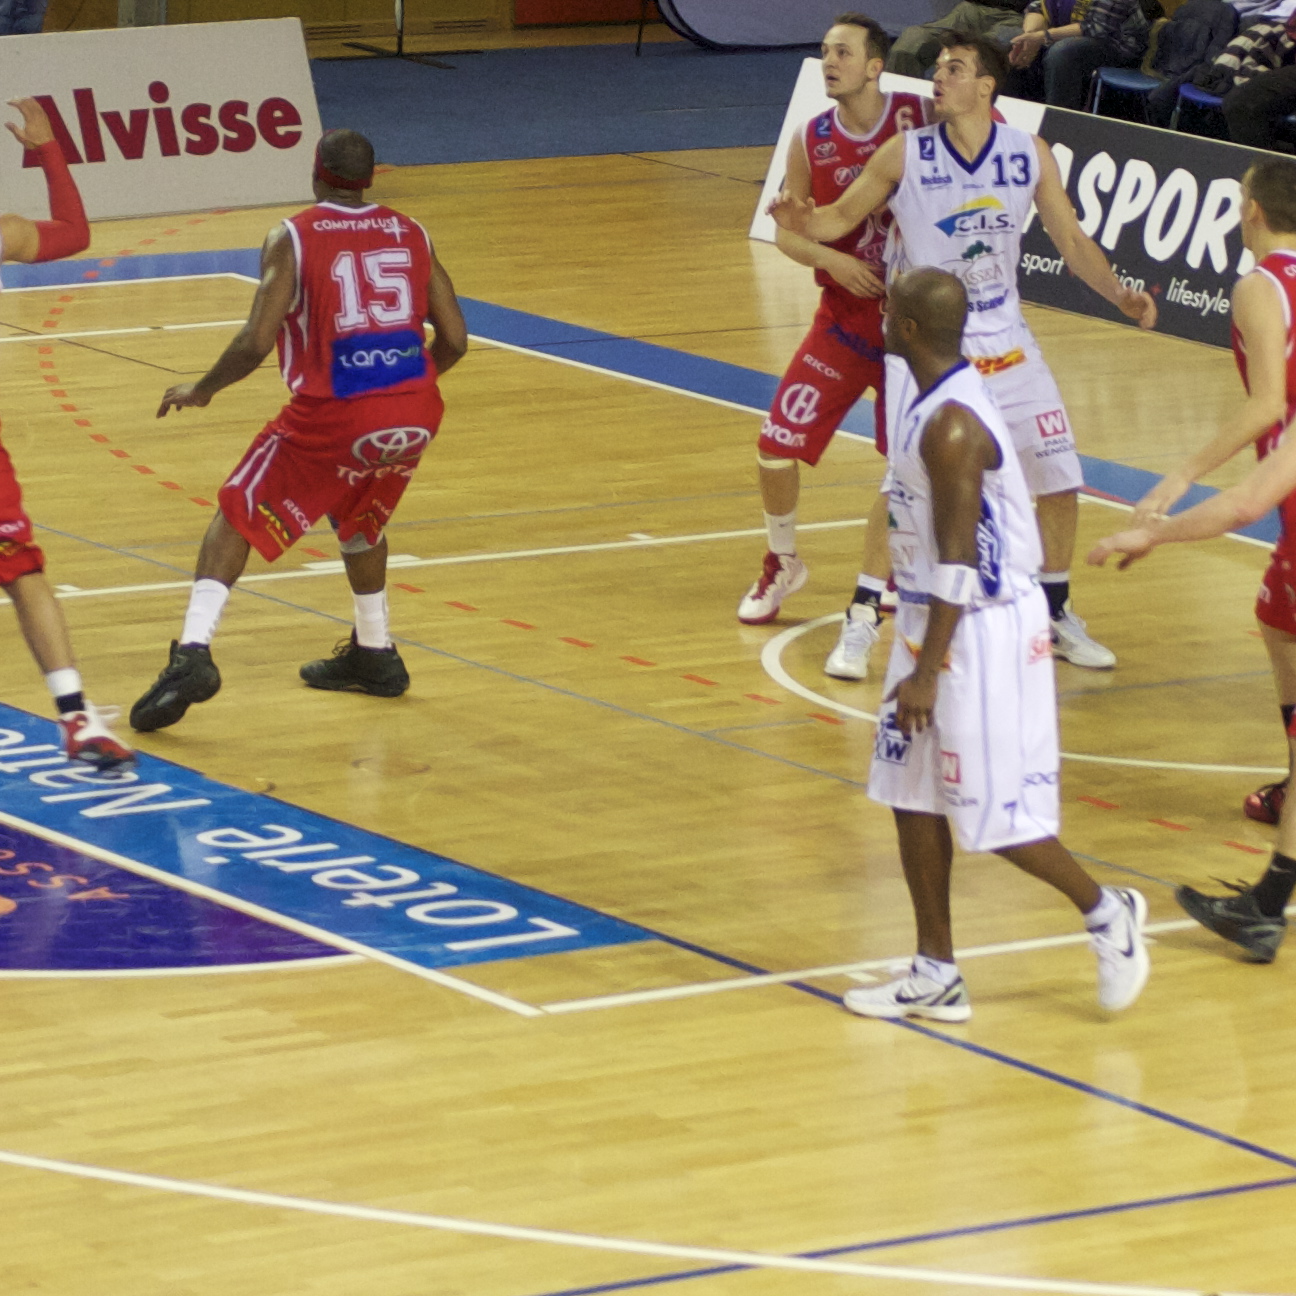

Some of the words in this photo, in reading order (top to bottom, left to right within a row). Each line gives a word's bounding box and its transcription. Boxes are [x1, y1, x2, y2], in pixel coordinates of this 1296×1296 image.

[22, 80, 303, 170] Alvisse
[991, 153, 1032, 187] 13
[312, 217, 394, 232] COMPTAPLUS
[956, 213, 1015, 233] C.I.S.
[331, 247, 413, 333] 15
[1021, 252, 1064, 276] sport
[1166, 277, 1230, 316] lifestyle
[282, 498, 312, 532] RICO
[196, 823, 581, 952] Loterie
